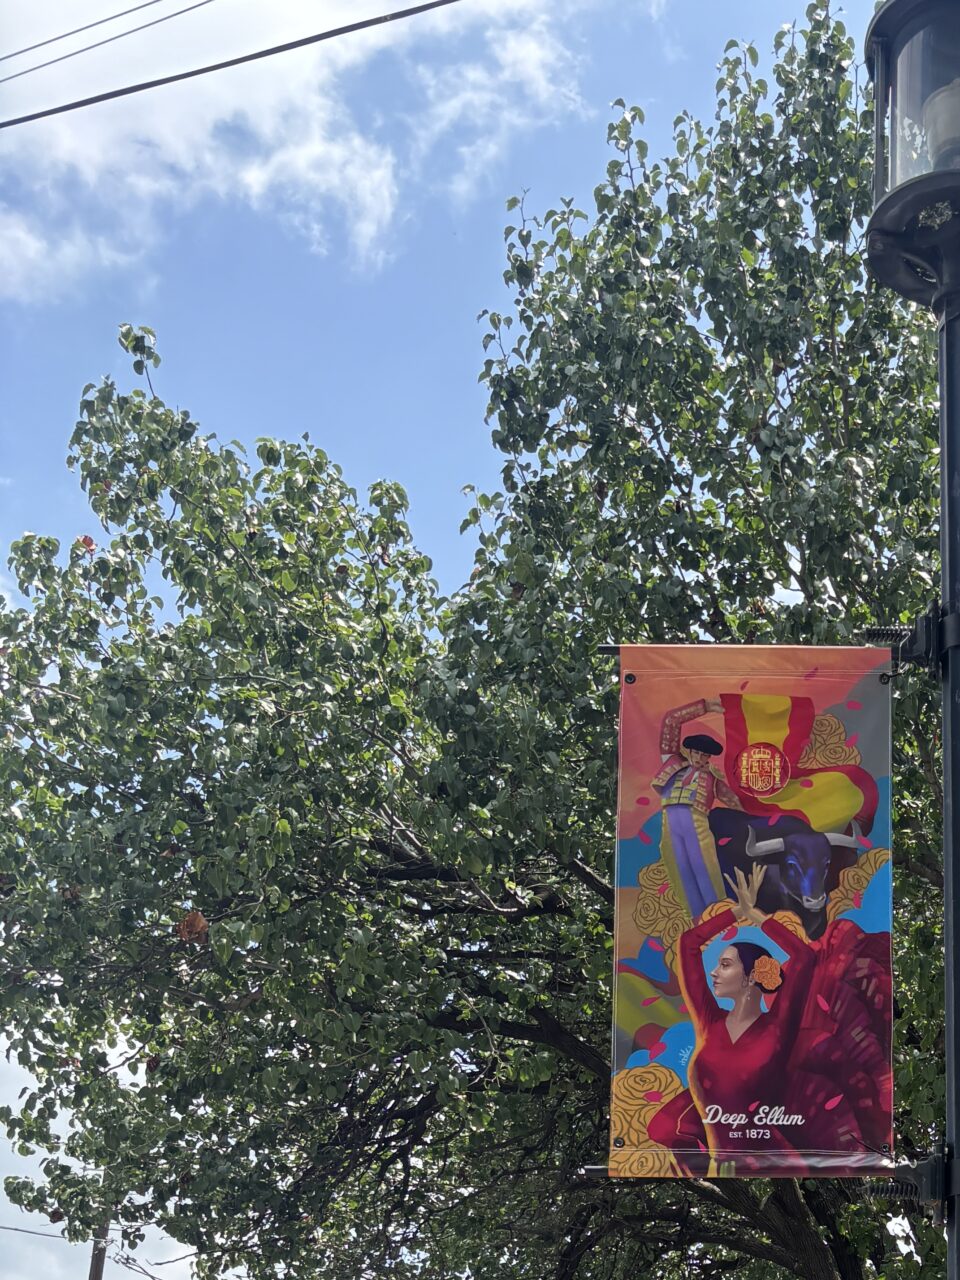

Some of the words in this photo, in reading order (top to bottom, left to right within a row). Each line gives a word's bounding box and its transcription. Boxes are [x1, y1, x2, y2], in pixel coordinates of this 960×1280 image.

[702, 1104, 748, 1129] Deep
[753, 1105, 806, 1126] Ellum
[745, 1129, 771, 1139] 1873
